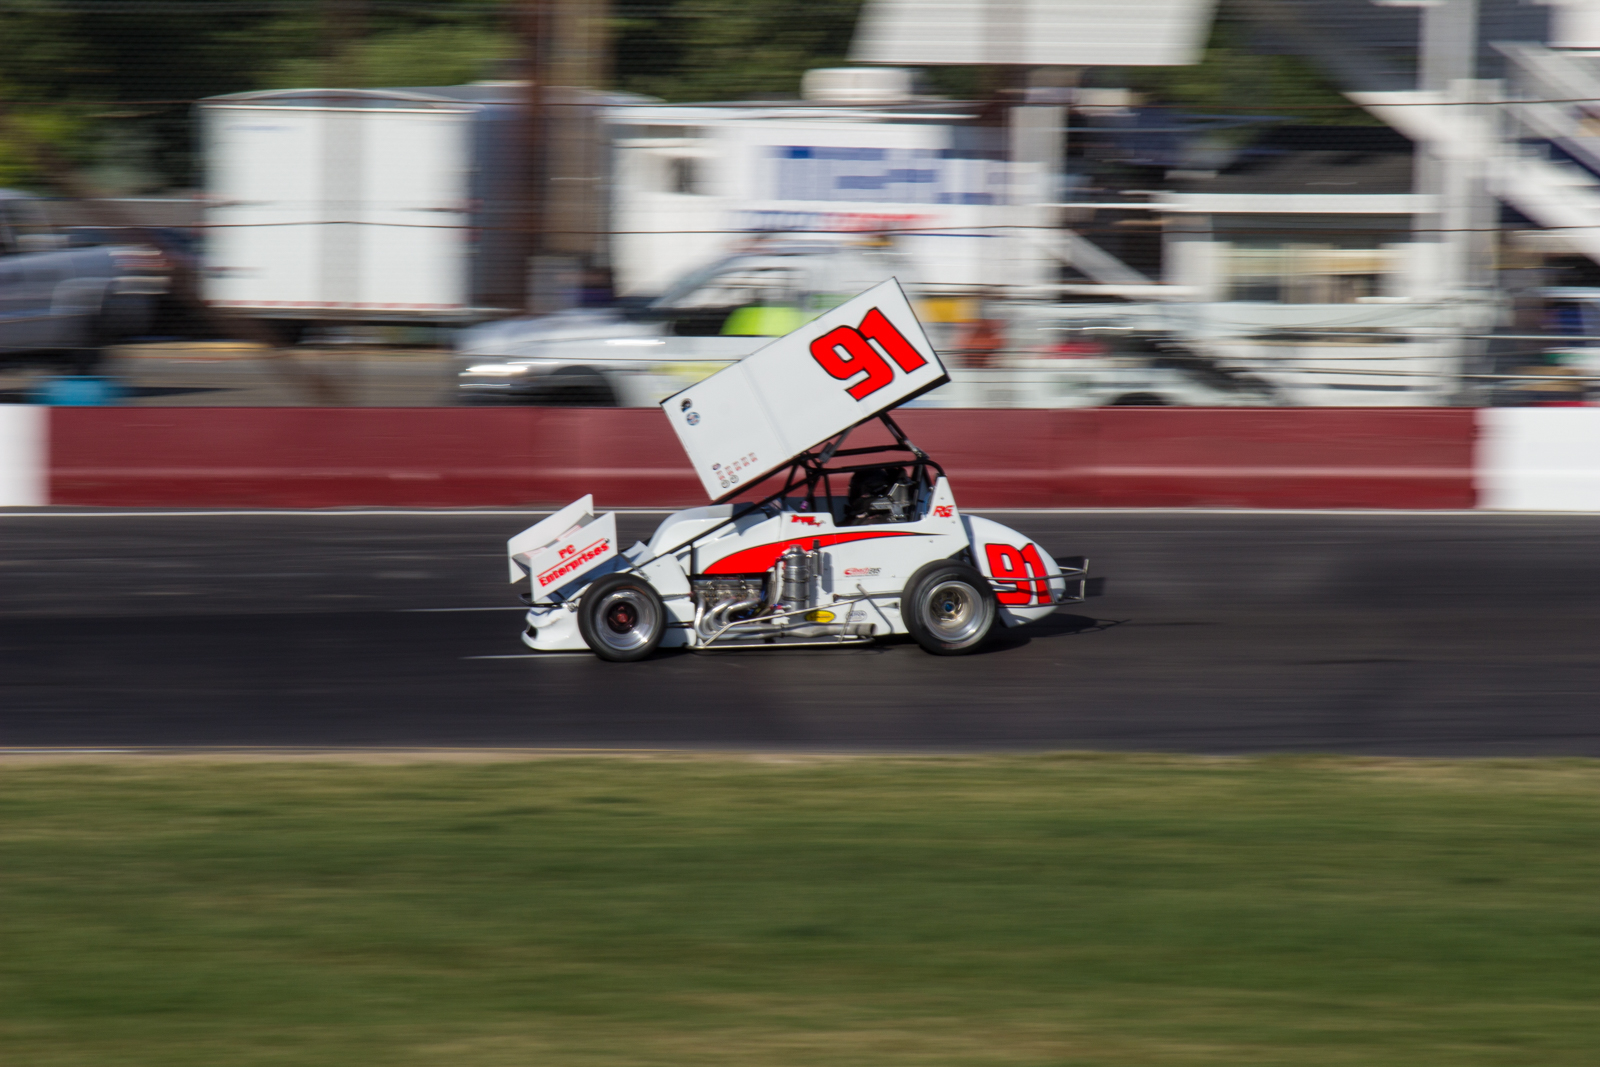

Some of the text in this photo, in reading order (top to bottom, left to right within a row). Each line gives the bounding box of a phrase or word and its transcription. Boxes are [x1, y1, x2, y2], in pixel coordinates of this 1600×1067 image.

[810, 307, 927, 401] 91
[538, 542, 610, 587] Enterprises
[558, 544, 577, 559] PC
[985, 542, 1052, 605] 91
